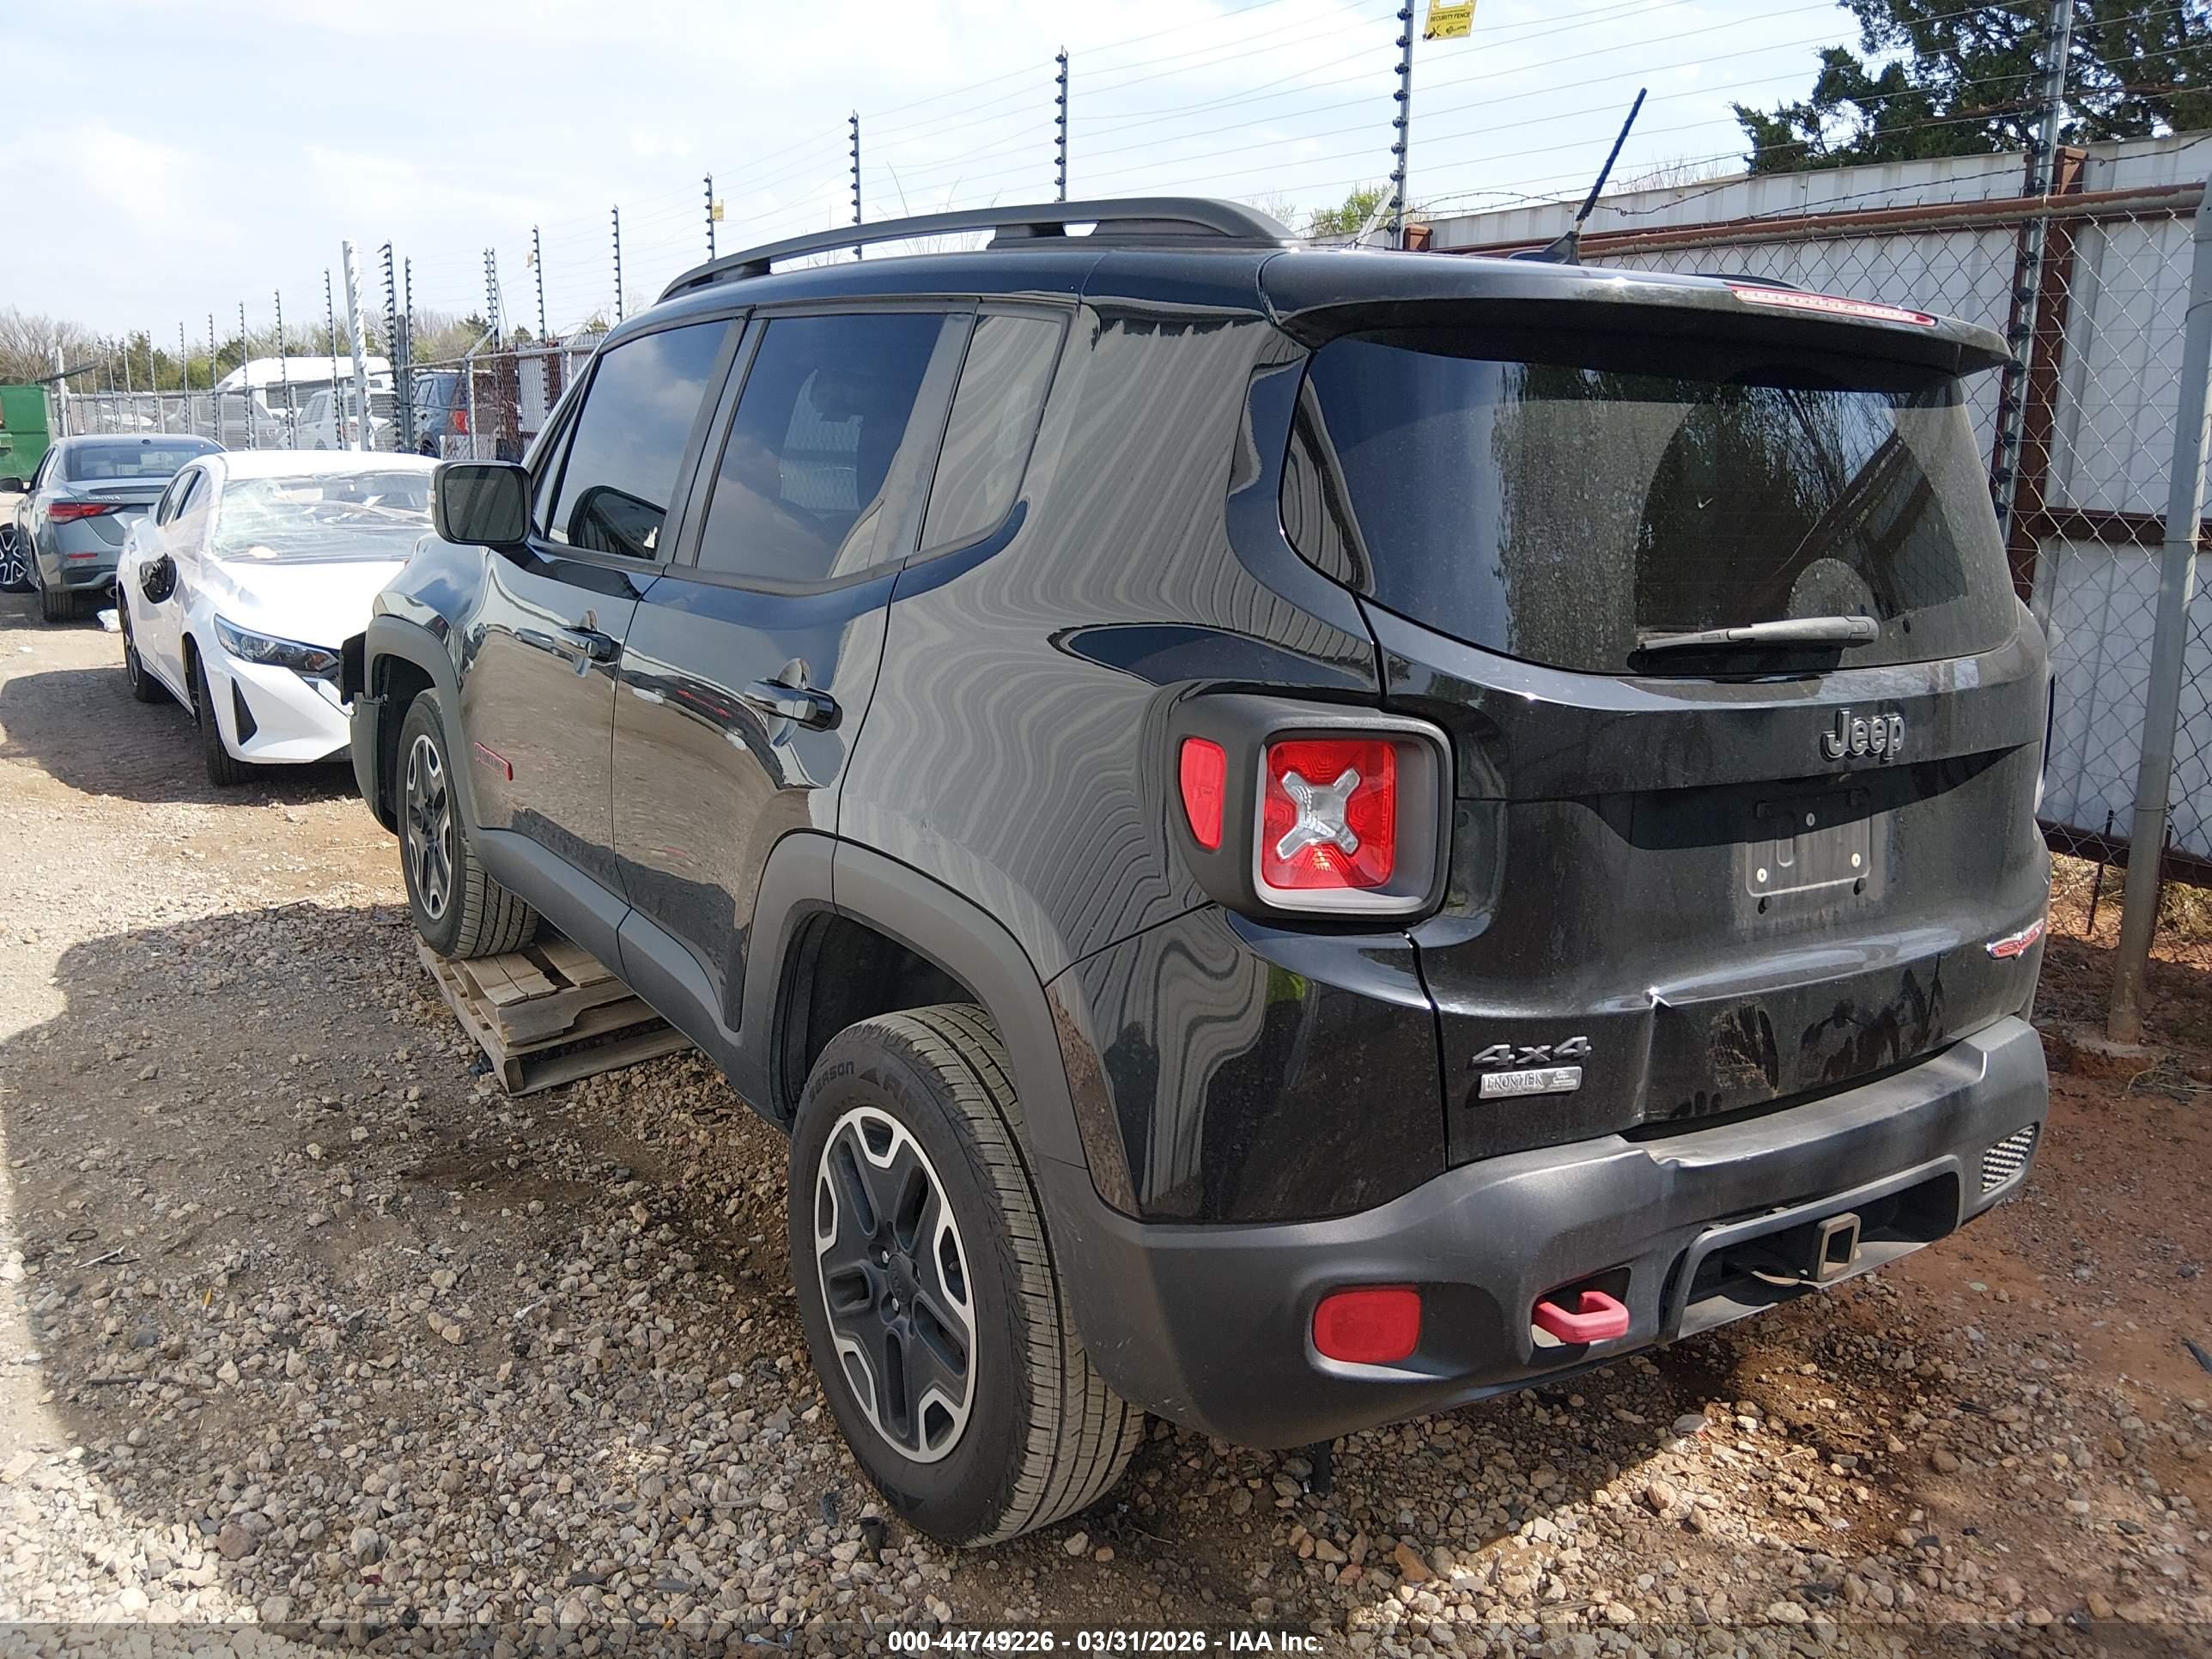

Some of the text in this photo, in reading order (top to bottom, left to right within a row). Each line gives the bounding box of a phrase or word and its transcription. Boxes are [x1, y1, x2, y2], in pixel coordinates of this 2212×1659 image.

[1430, 14, 1454, 22] SECURITY
[1454, 11, 1471, 20] FENCE
[1820, 708, 1905, 763] Jeep
[1471, 1036, 1593, 1066] 4x4
[1484, 1072, 1545, 1091] FRONTIER
